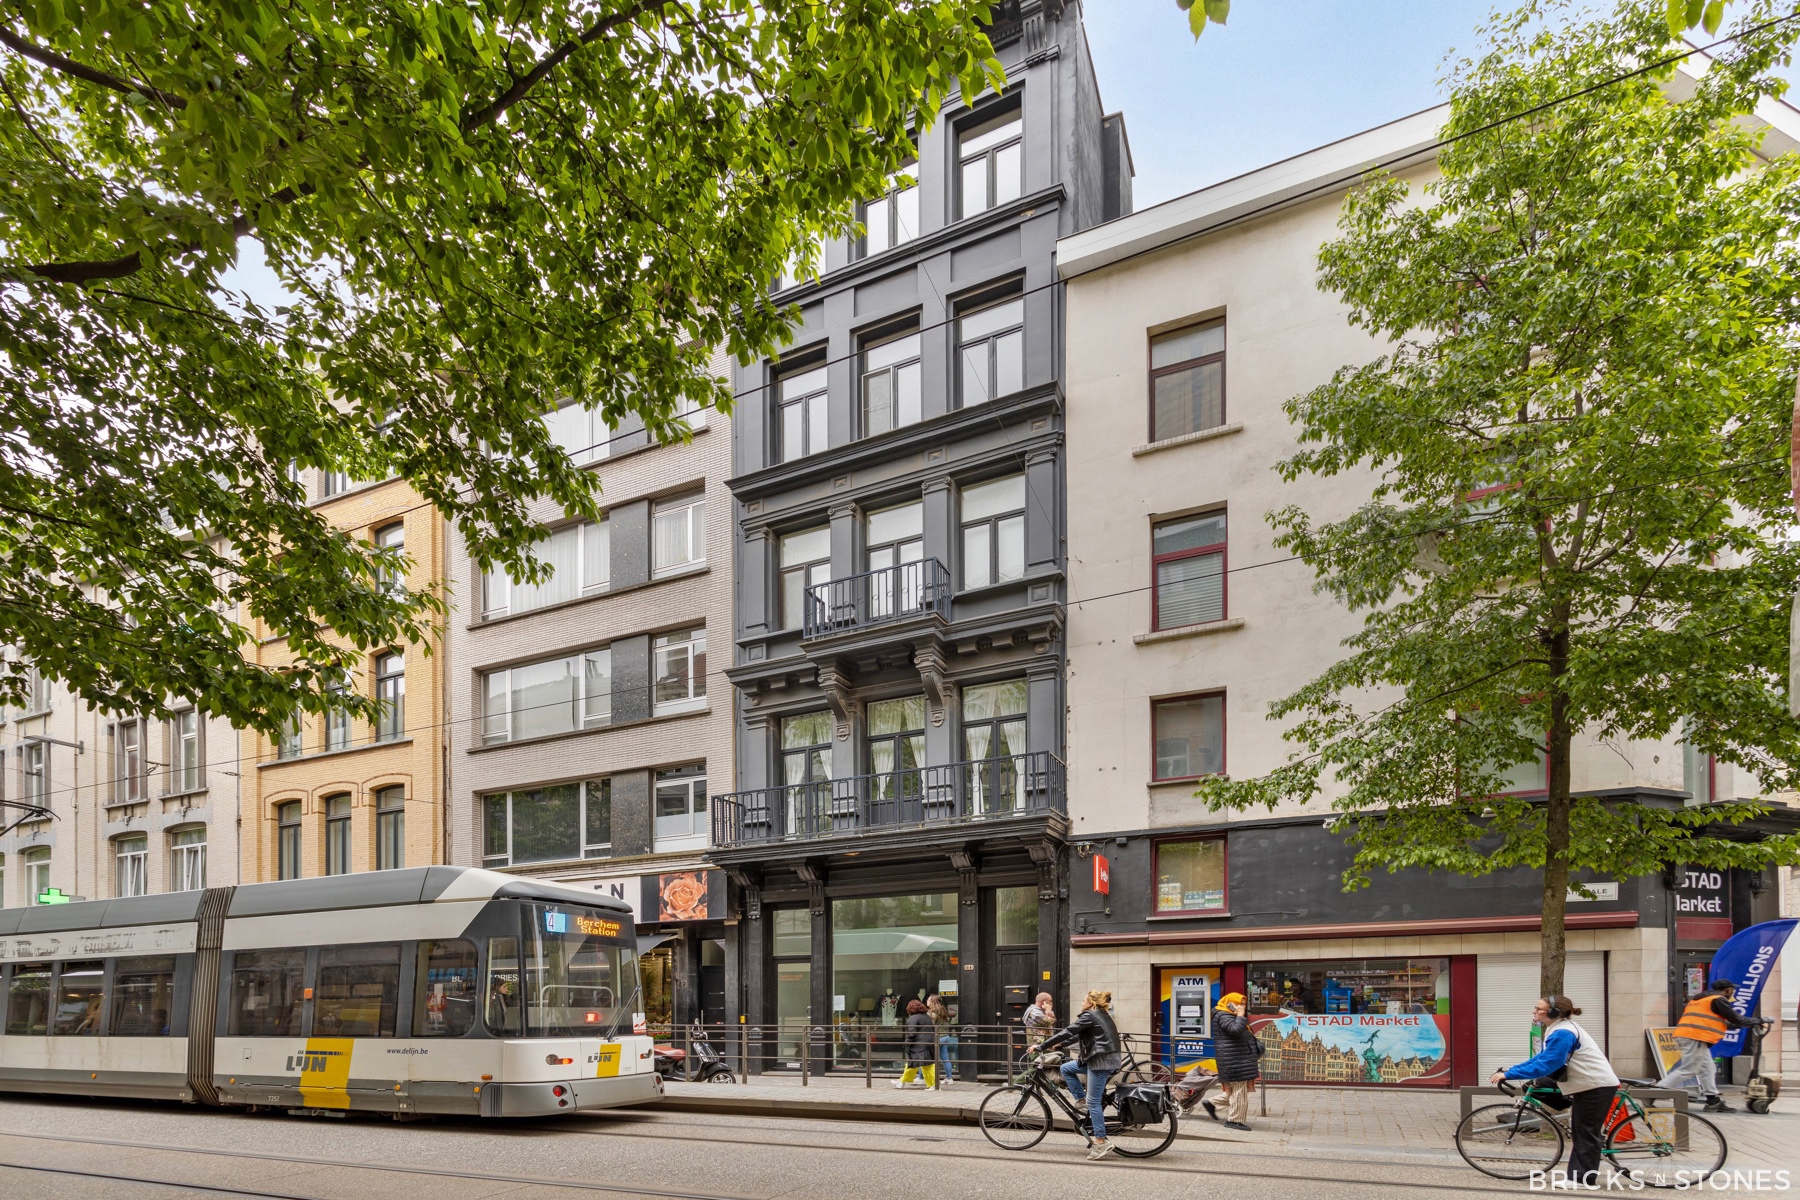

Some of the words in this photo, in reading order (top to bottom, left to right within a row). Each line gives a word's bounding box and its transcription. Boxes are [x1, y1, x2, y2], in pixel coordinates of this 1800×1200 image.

[577, 917, 620, 930] Berchem
[581, 926, 617, 936] Station
[1178, 977, 1204, 985] ATM
[1295, 1015, 1353, 1026] T'STAD
[1360, 1015, 1420, 1026] Market
[1178, 1042, 1204, 1050] ATM
